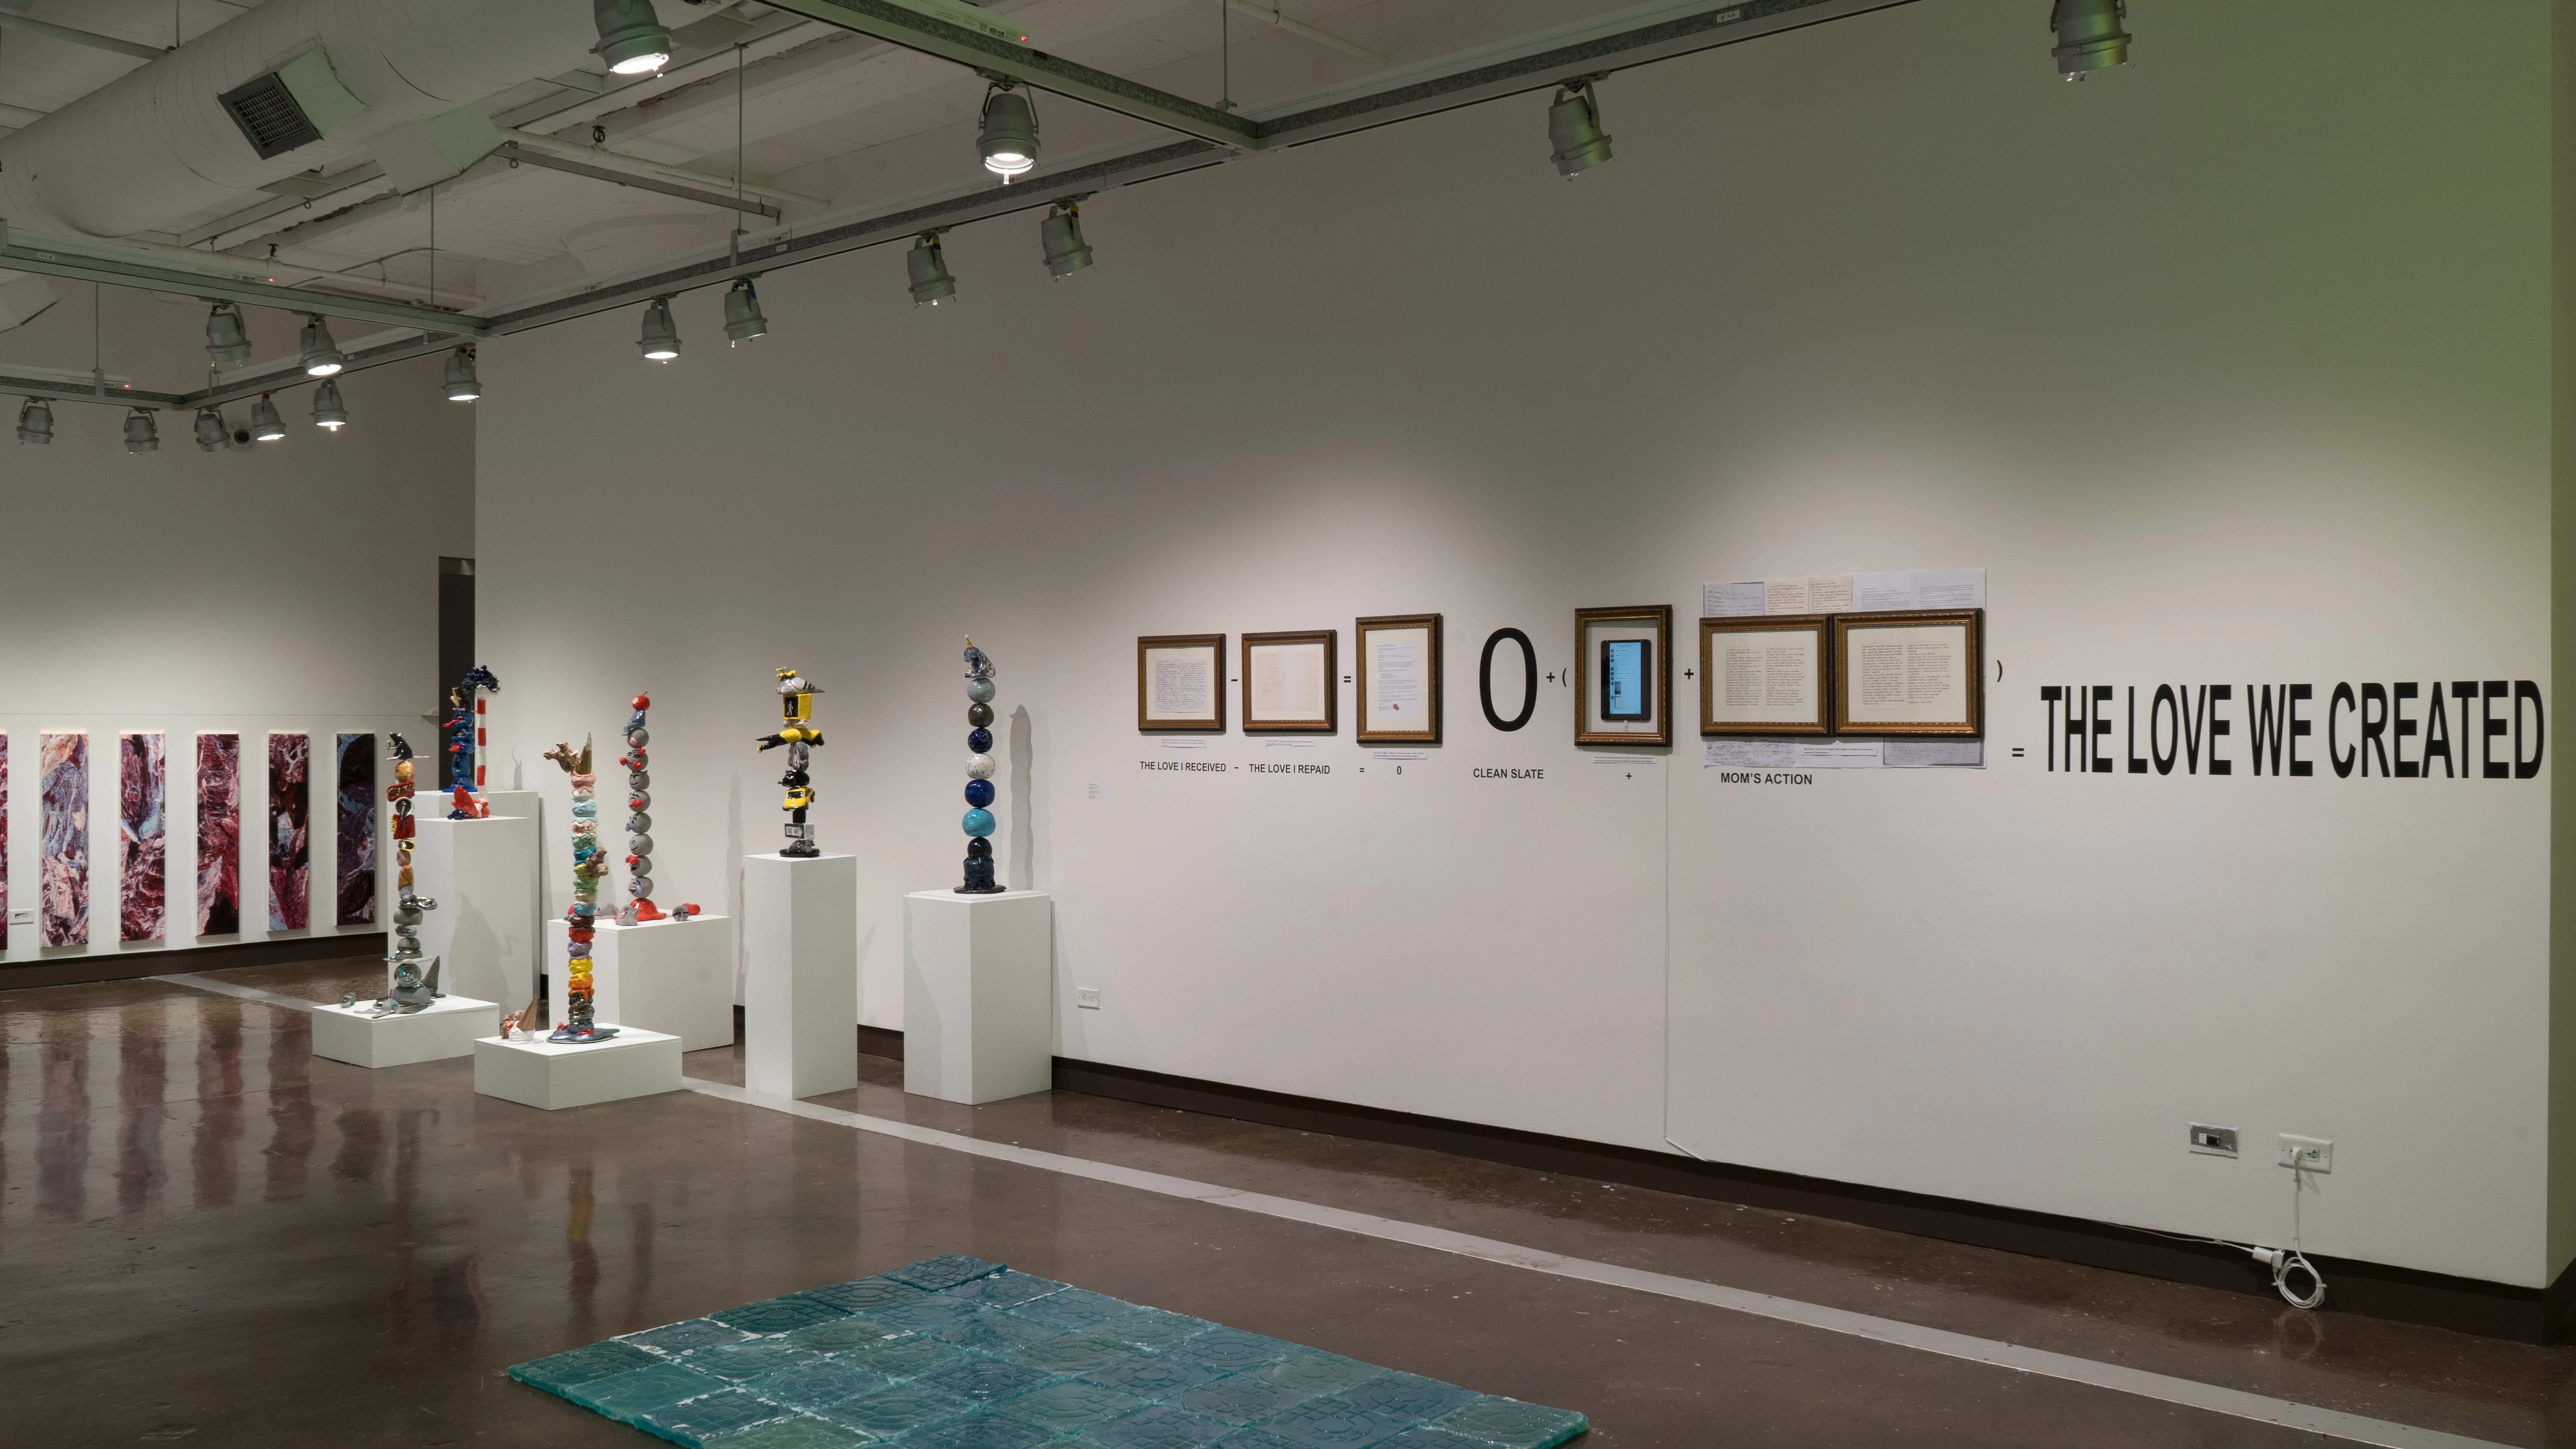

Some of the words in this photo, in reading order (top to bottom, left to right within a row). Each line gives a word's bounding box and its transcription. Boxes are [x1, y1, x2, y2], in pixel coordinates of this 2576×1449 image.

[2041, 685, 2113, 773] THE
[2128, 683, 2231, 776] LOVE
[2247, 683, 2313, 777] WE
[2329, 680, 2544, 779] CREATED
[1139, 761, 1155, 770] THE
[1157, 762, 1179, 770] LOVE
[1185, 762, 1226, 772] RECEIVED
[1249, 764, 1266, 773] THE
[1268, 764, 1291, 773] LOVE
[1298, 764, 1330, 774] REPAID
[1473, 768, 1507, 778] CLEAN
[1511, 769, 1544, 779] SLATE
[1764, 773, 1812, 785] ACTION
